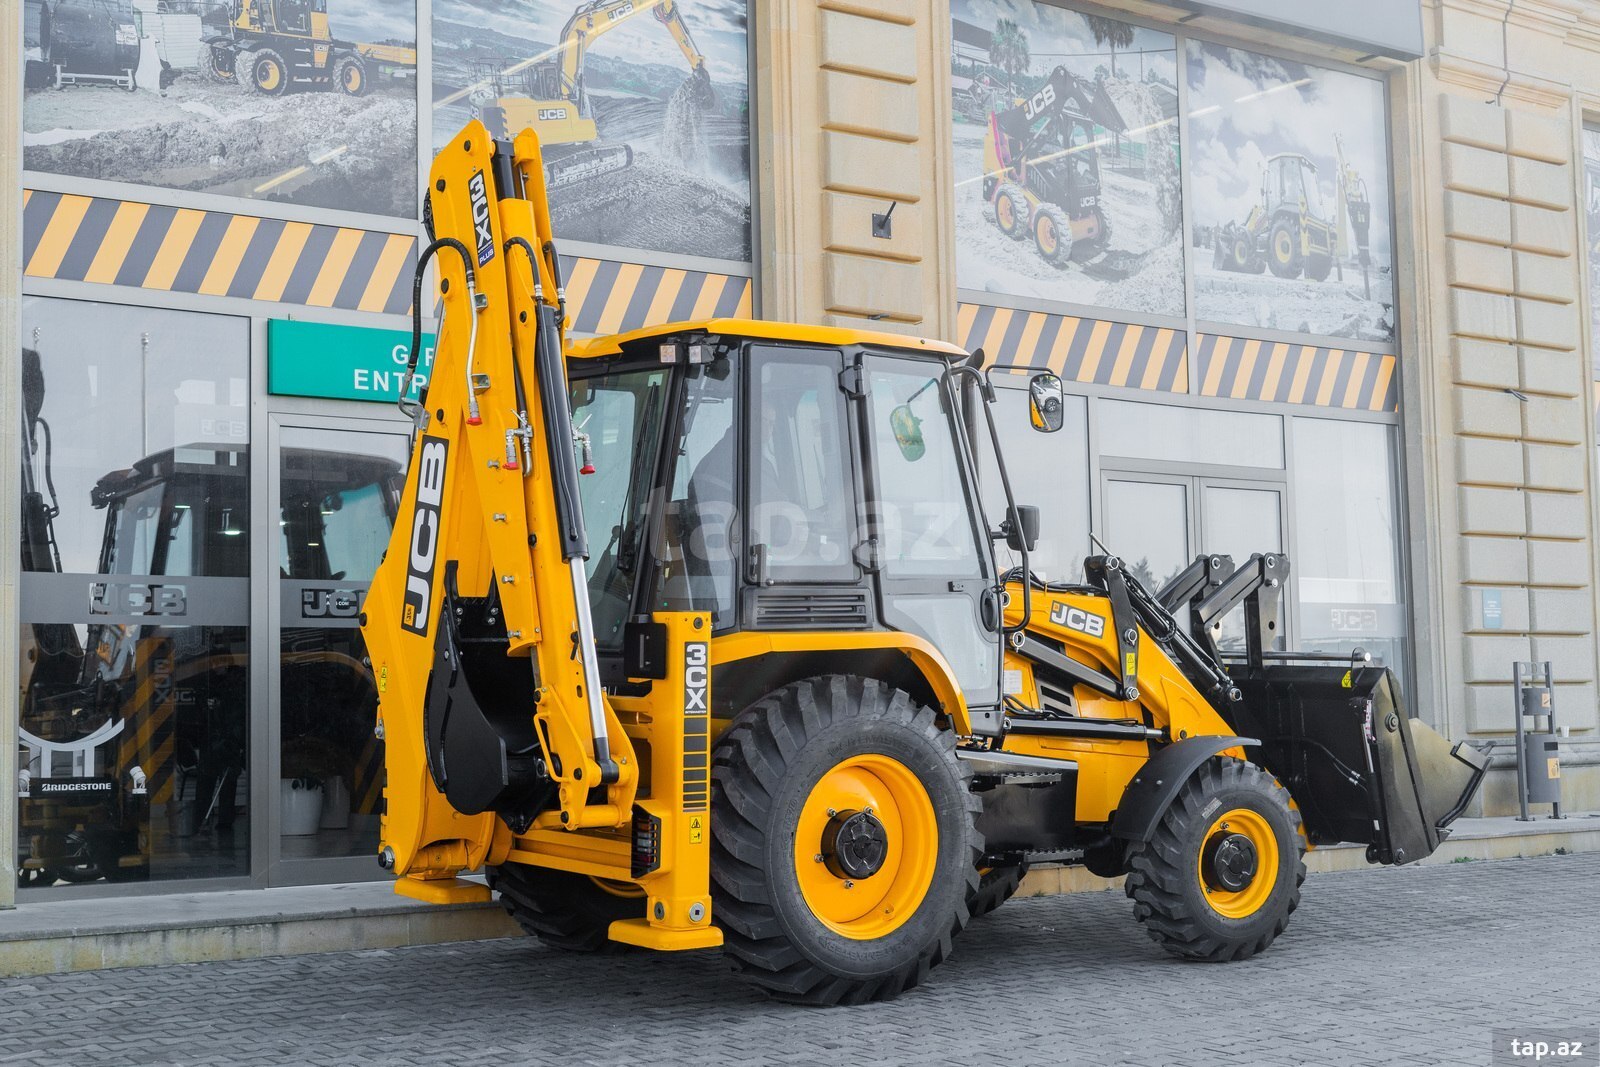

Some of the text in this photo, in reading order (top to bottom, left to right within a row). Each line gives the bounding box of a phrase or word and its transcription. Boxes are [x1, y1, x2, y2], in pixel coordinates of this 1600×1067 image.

[610, 4, 633, 22] JCB
[539, 109, 567, 120] JCB
[1025, 84, 1056, 121] JCB
[470, 174, 492, 249] 3CX
[1081, 196, 1096, 208] JCB
[408, 442, 446, 630] JCB
[91, 585, 185, 613] JCB
[1051, 603, 1104, 636] JCB
[686, 644, 707, 710] 3CX
[41, 782, 112, 792] BRIDGESTONE
